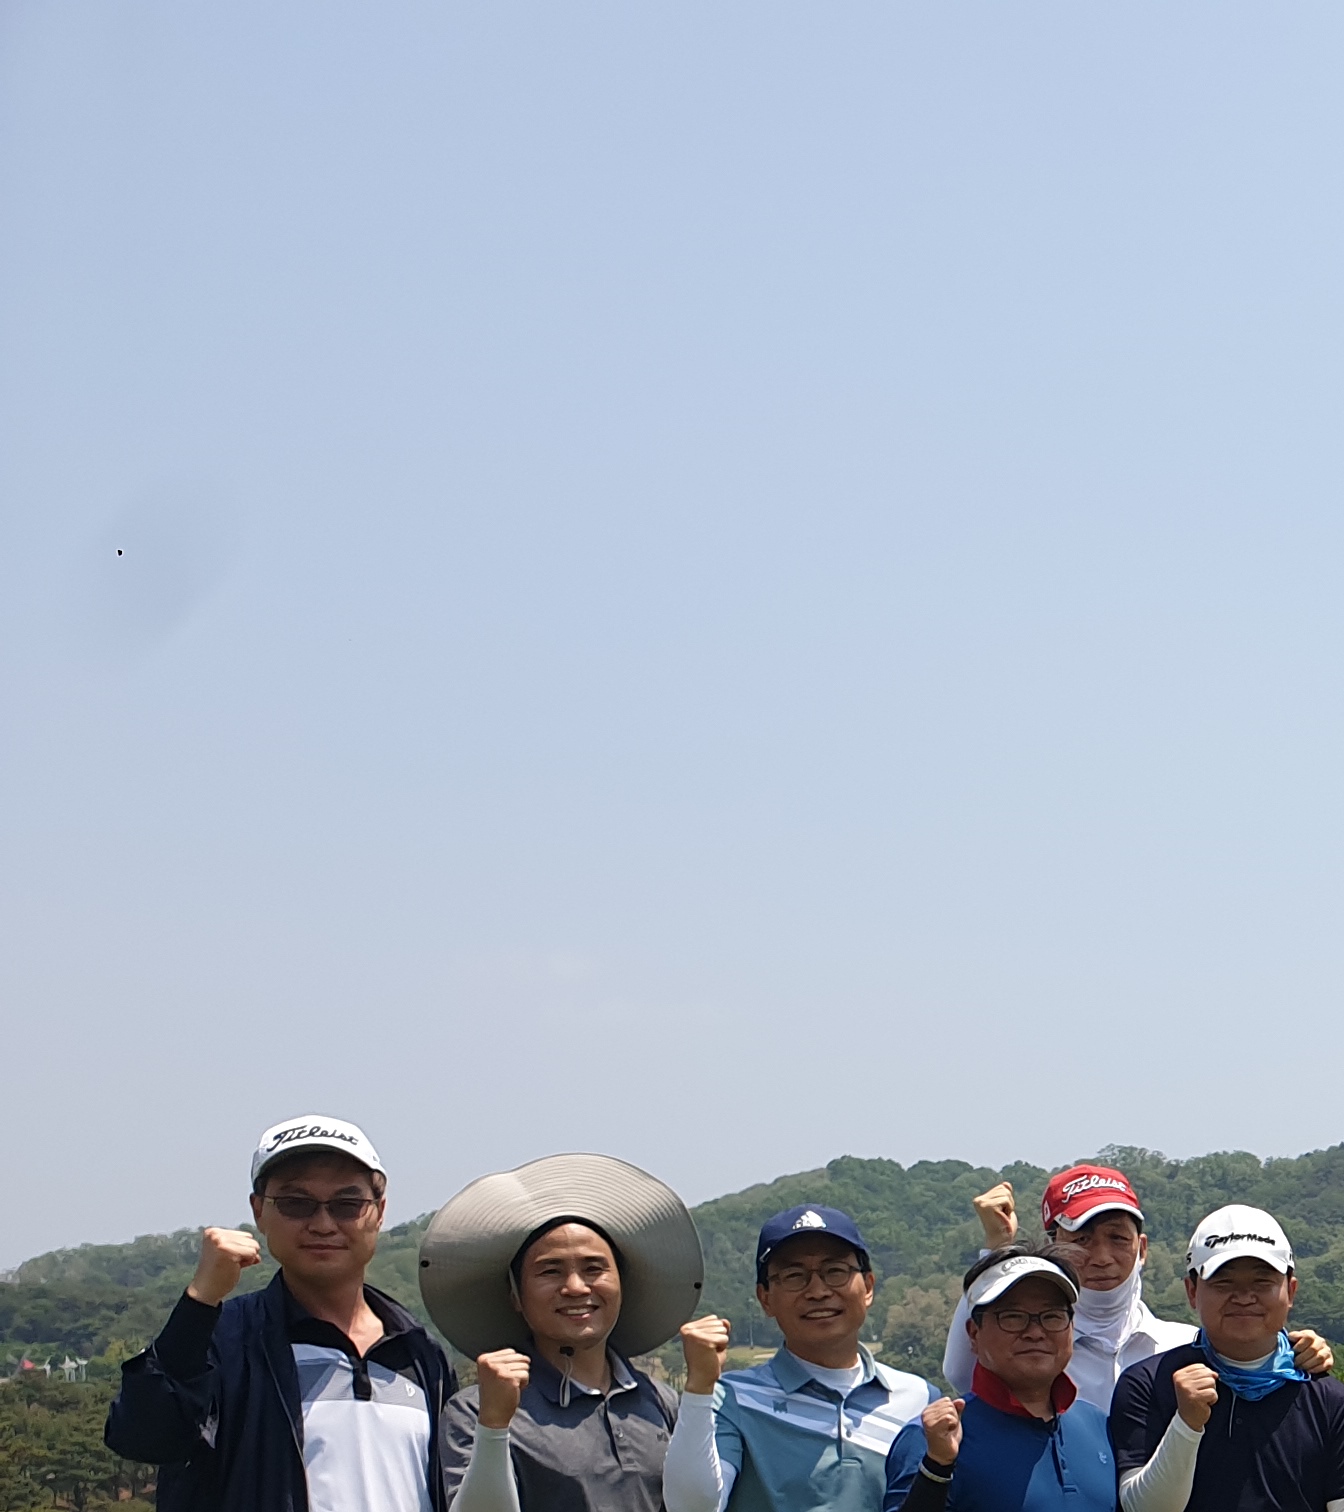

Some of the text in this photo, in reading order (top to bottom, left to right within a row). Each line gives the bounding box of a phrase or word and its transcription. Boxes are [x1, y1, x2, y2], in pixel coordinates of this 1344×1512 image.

[266, 1124, 359, 1152] Titleist
[1061, 1174, 1127, 1204] Titleist
[1204, 1231, 1276, 1249] TaylorMade
